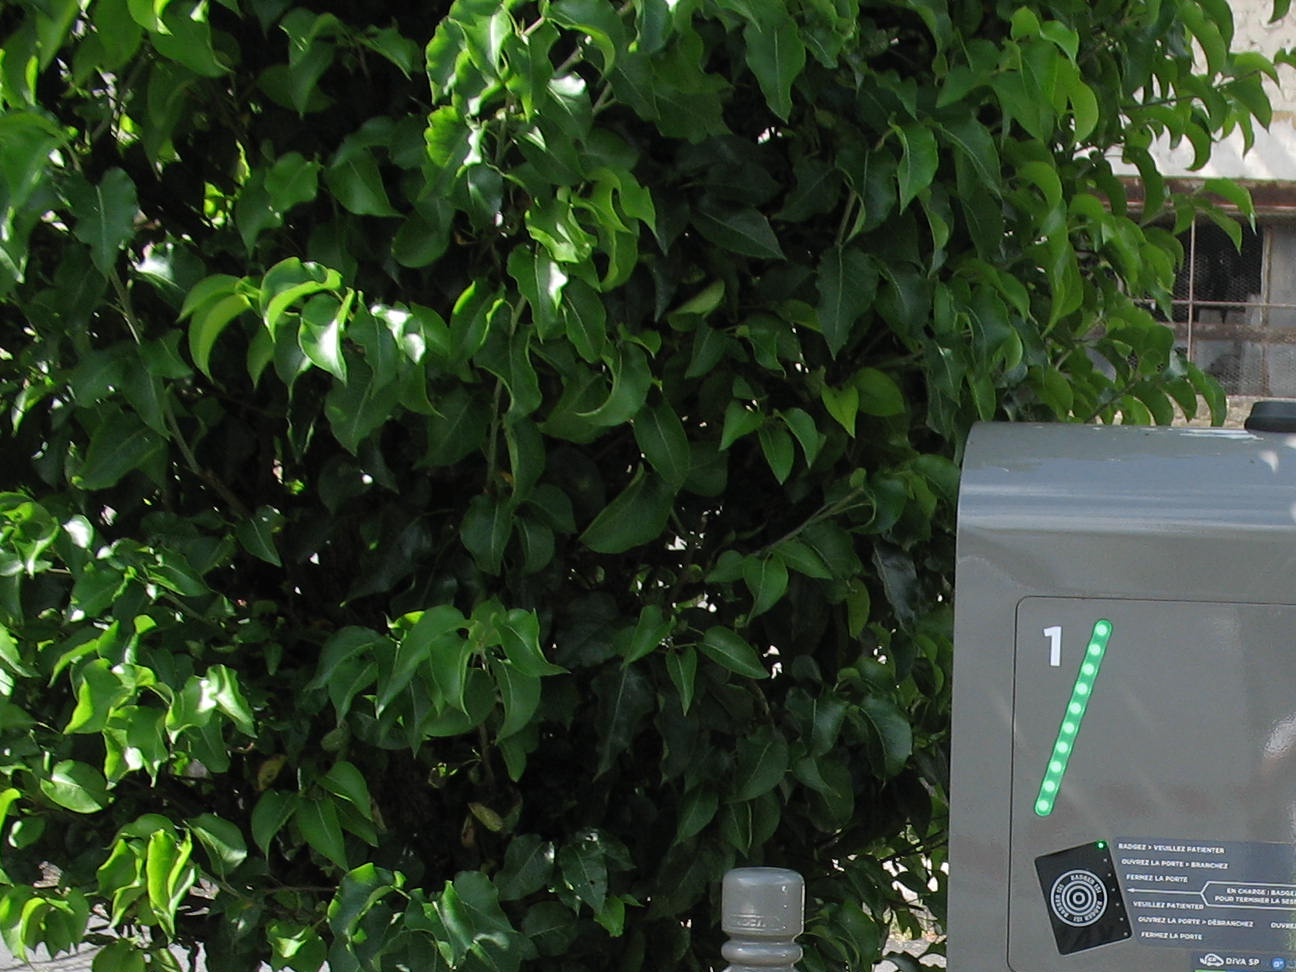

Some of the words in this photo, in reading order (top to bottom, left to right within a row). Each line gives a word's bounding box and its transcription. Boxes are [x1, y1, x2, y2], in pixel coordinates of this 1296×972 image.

[1043, 626, 1062, 667] 1
[1118, 843, 1147, 851] BADGEZ
[1153, 845, 1186, 853] VEUILLEZ
[1186, 846, 1225, 854] PATIENTER
[1138, 916, 1166, 924] OUVREZ
